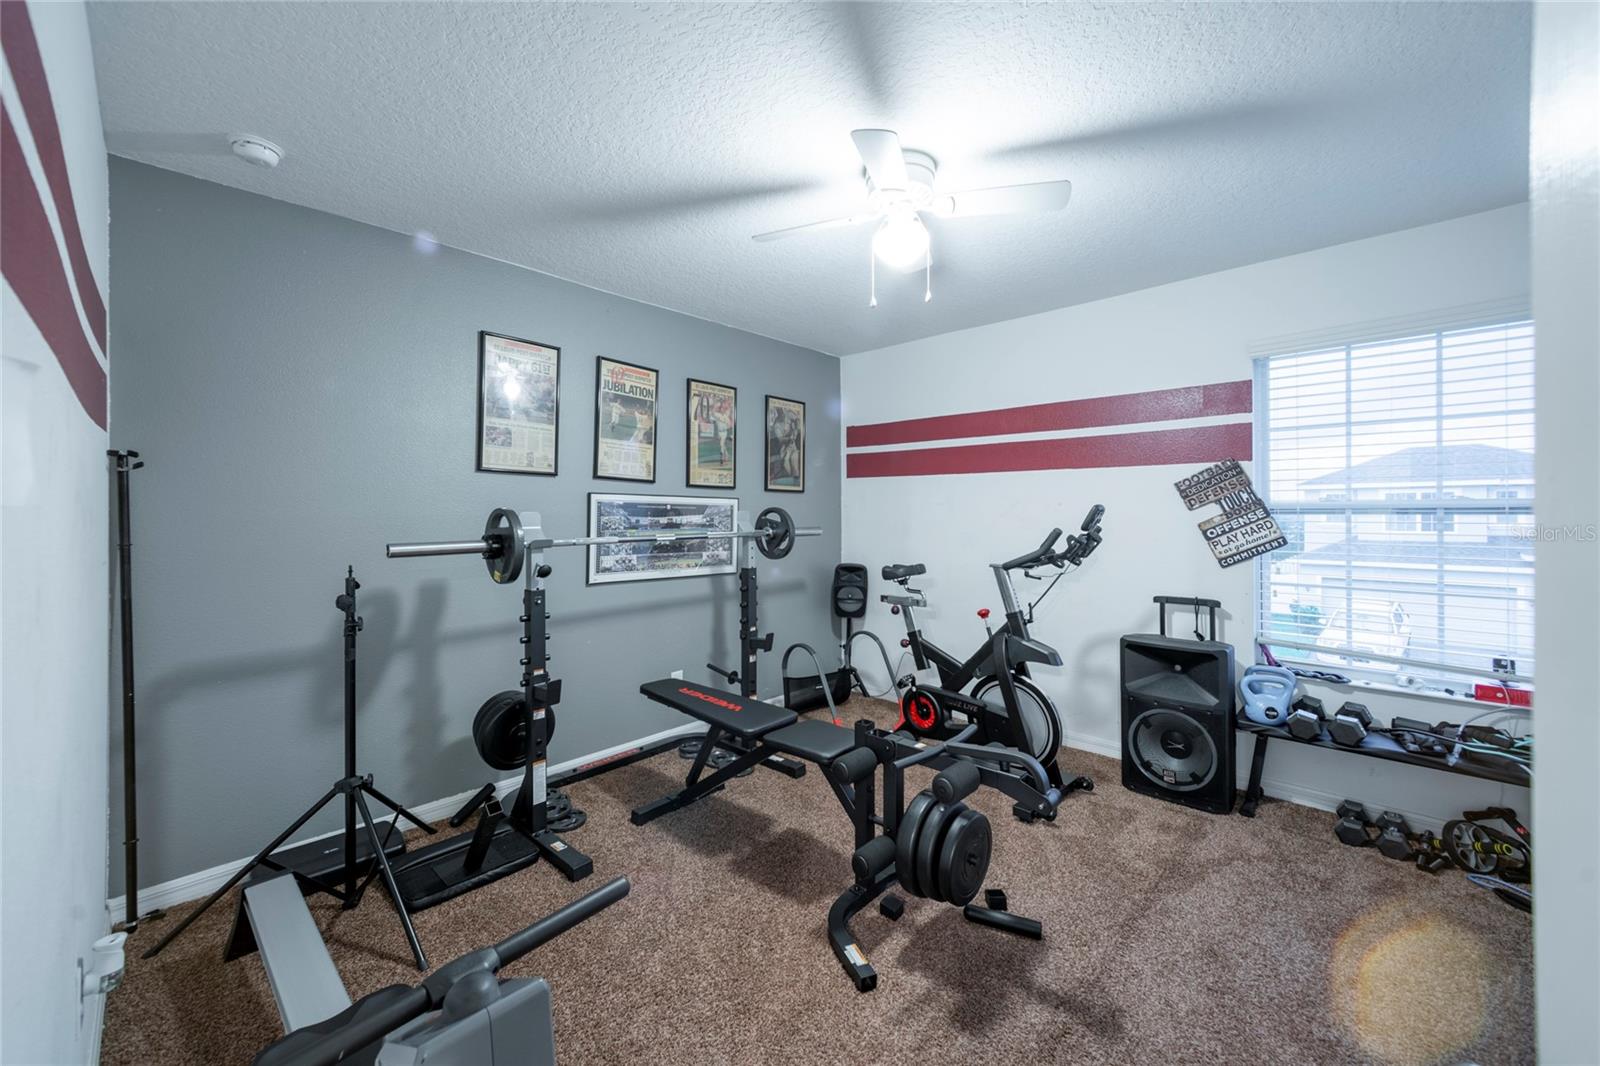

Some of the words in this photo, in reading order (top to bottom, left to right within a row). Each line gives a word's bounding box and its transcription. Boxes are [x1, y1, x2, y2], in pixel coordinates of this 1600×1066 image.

[602, 378, 654, 400] JUBILATION
[1174, 457, 1240, 490] FOOTBALL
[1188, 476, 1248, 508] DEFENSE
[1217, 486, 1259, 513] TOUCH
[1206, 508, 1267, 539] OFFENSE
[1226, 499, 1265, 519] DOWN
[1211, 531, 1240, 551] PLAY
[1241, 519, 1274, 540] HARD
[1221, 538, 1284, 567] COMMITMENT
[678, 687, 744, 712] WEIDER
